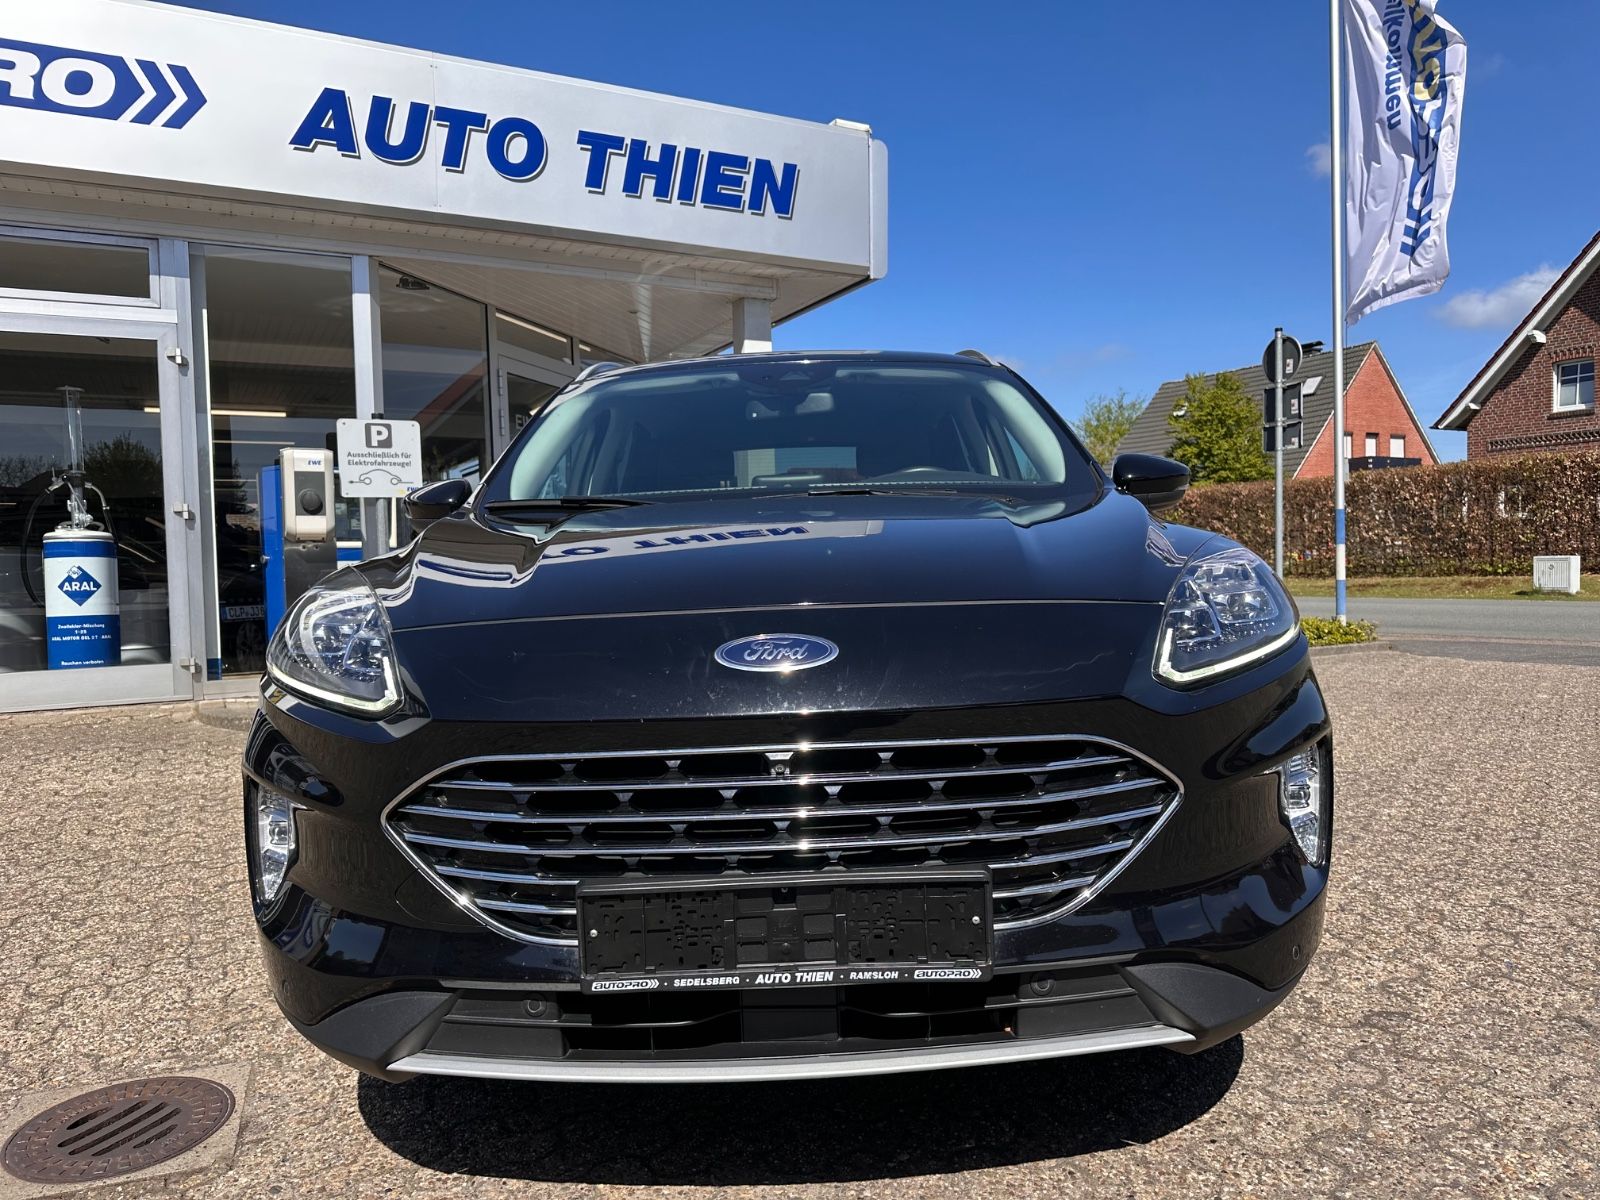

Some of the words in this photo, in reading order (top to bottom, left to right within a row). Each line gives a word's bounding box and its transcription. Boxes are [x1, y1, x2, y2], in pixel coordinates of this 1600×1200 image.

[289, 87, 547, 182] AUTO
[577, 130, 799, 218] THIEN
[370, 425, 389, 447] P
[347, 451, 400, 459] Ausschließlich
[401, 451, 412, 459] für
[347, 459, 412, 468] Elektrofahrzeuge!
[63, 581, 97, 591] ARAL
[744, 639, 809, 660] Ford
[673, 976, 740, 987] SEDELSBERG
[755, 973, 791, 984] AUTO
[795, 971, 834, 983] THIEN
[849, 970, 899, 980] RAMSLOH
